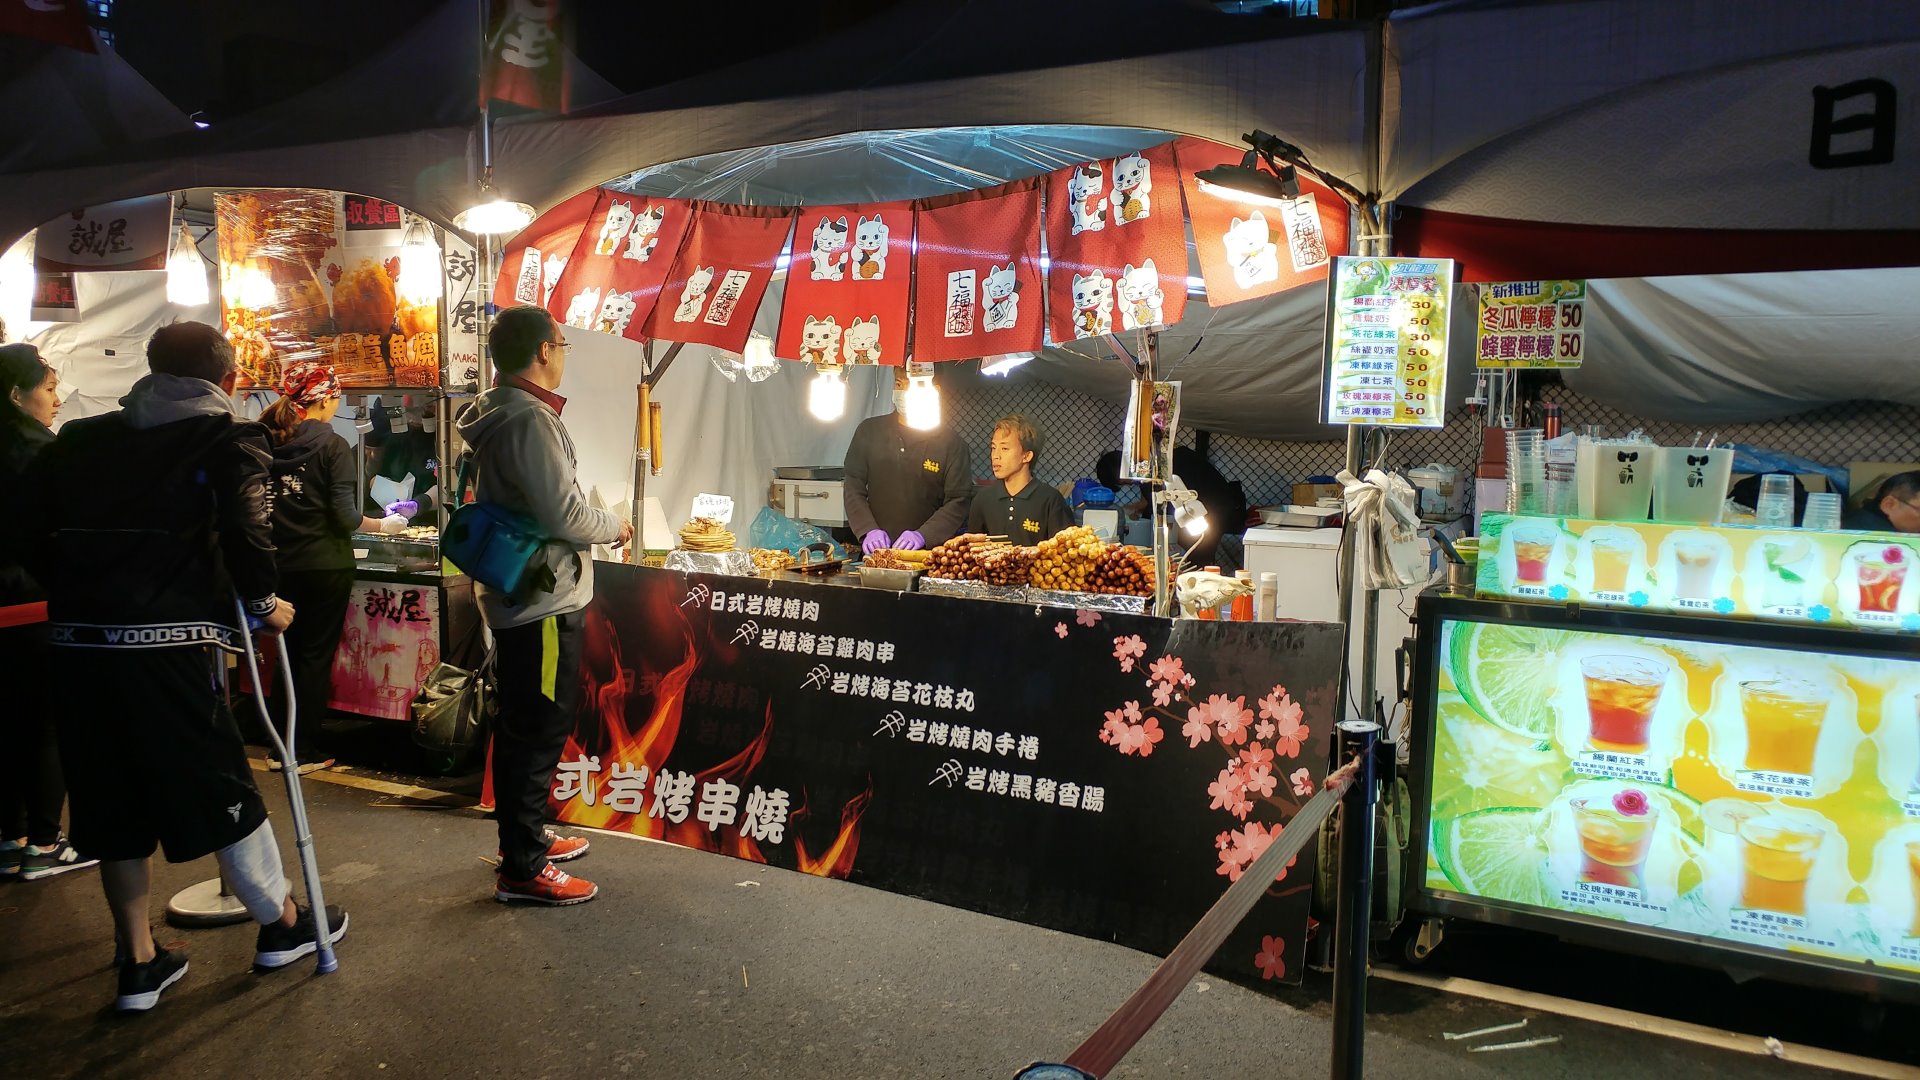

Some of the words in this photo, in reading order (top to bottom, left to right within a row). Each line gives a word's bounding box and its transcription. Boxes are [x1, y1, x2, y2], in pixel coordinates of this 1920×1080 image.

[1809, 77, 1897, 170] 日
[347, 198, 399, 225] 取餐區
[69, 218, 134, 258] 誠屋
[1492, 281, 1540, 299] 新推出
[1412, 301, 1431, 309] 30
[1410, 317, 1430, 326] 50
[1483, 305, 1556, 330] 冬瓜檸檬
[1561, 303, 1582, 328] 50
[1351, 330, 1396, 339] 茶花綠茶
[1350, 346, 1395, 355] 絲襪奶茶
[1407, 347, 1430, 356] 50
[1481, 335, 1555, 358] 蜂蜜檸檬
[1560, 333, 1581, 358] 50
[1350, 361, 1394, 371] 凍檸綠茶
[1406, 363, 1428, 371] 50
[1360, 376, 1393, 386] 凍七茶
[1405, 378, 1427, 387] 50
[1343, 392, 1392, 401] 玫瑰凍檸茶
[1404, 392, 1426, 401] 50
[1341, 406, 1392, 416] 招牌凍檸茶
[1404, 407, 1426, 415] 50
[364, 587, 431, 624] 誠屋
[710, 591, 821, 622] 日式岩烤燒肉
[759, 628, 896, 664] 岩燒海苔雞肉串
[830, 671, 975, 713] 岩烤海苔花枝丸
[906, 718, 1040, 761] 岩烤燒肉手捲
[1592, 753, 1645, 766] 錫蘭紅茶
[965, 766, 1106, 813] 岩烤黑豬香腸
[1751, 772, 1810, 787] 茶花綠茶
[553, 753, 791, 845] 式岩烤串燒
[1580, 883, 1638, 900] 玫瑰凍檸茶
